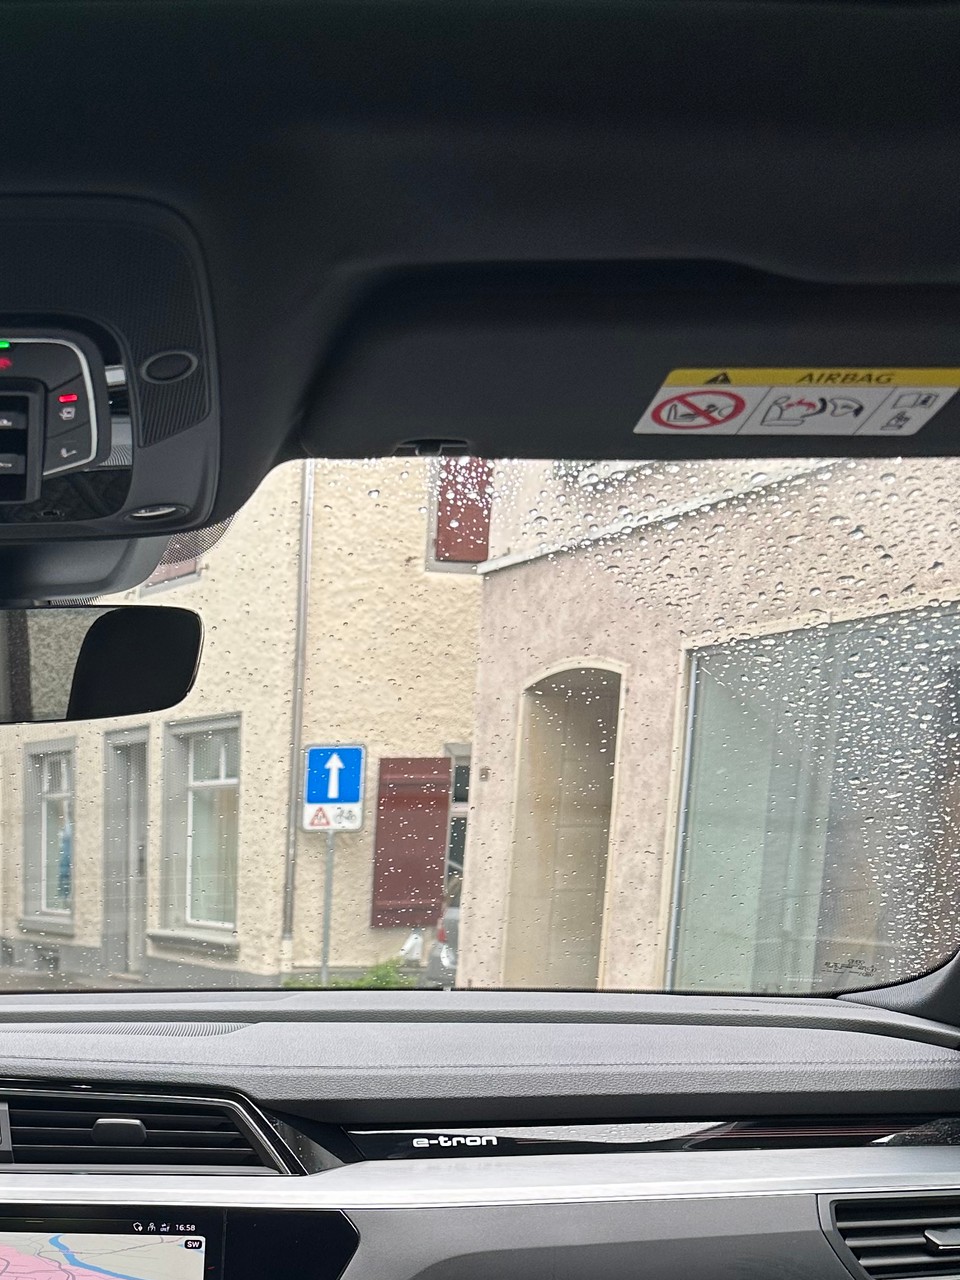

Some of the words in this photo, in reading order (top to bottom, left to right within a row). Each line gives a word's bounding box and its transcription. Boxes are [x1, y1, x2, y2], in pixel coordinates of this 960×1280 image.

[796, 372, 894, 384] AIRBAG
[412, 1135, 498, 1148] e-tron
[175, 1224, 196, 1232] 16:58
[186, 1240, 200, 1248] SW
